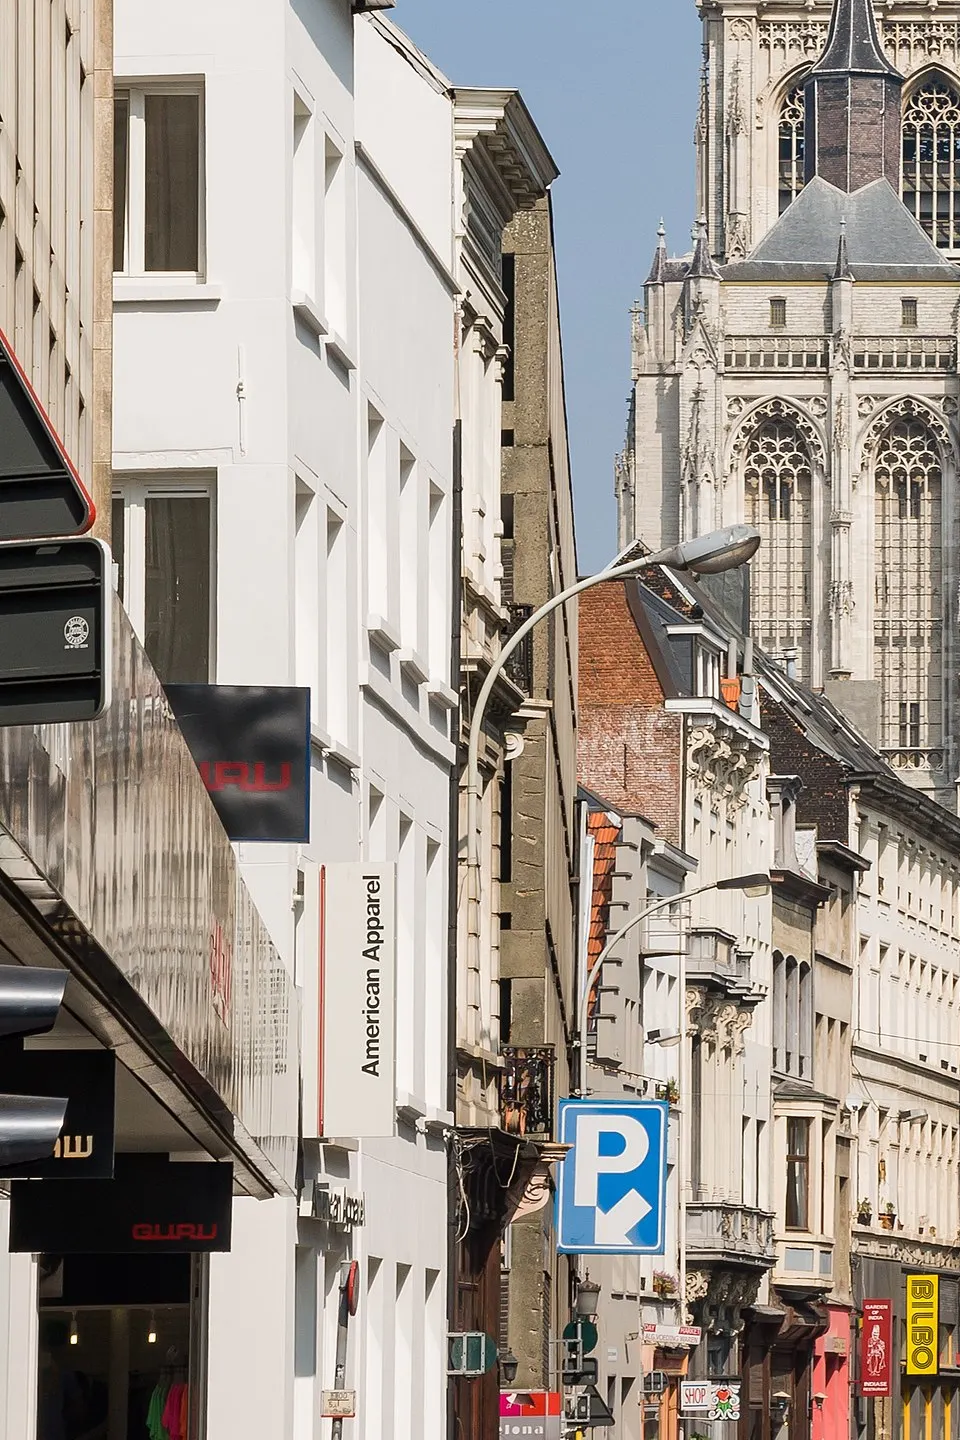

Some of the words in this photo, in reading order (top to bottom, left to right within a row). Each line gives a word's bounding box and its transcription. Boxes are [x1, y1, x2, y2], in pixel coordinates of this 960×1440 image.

[361, 875, 385, 962] Apparel
[361, 968, 380, 1078] American
[574, 1115, 650, 1207] P
[132, 1223, 217, 1241] GURU
[911, 1279, 934, 1370] BILBO
[684, 1387, 706, 1404] SHOP
